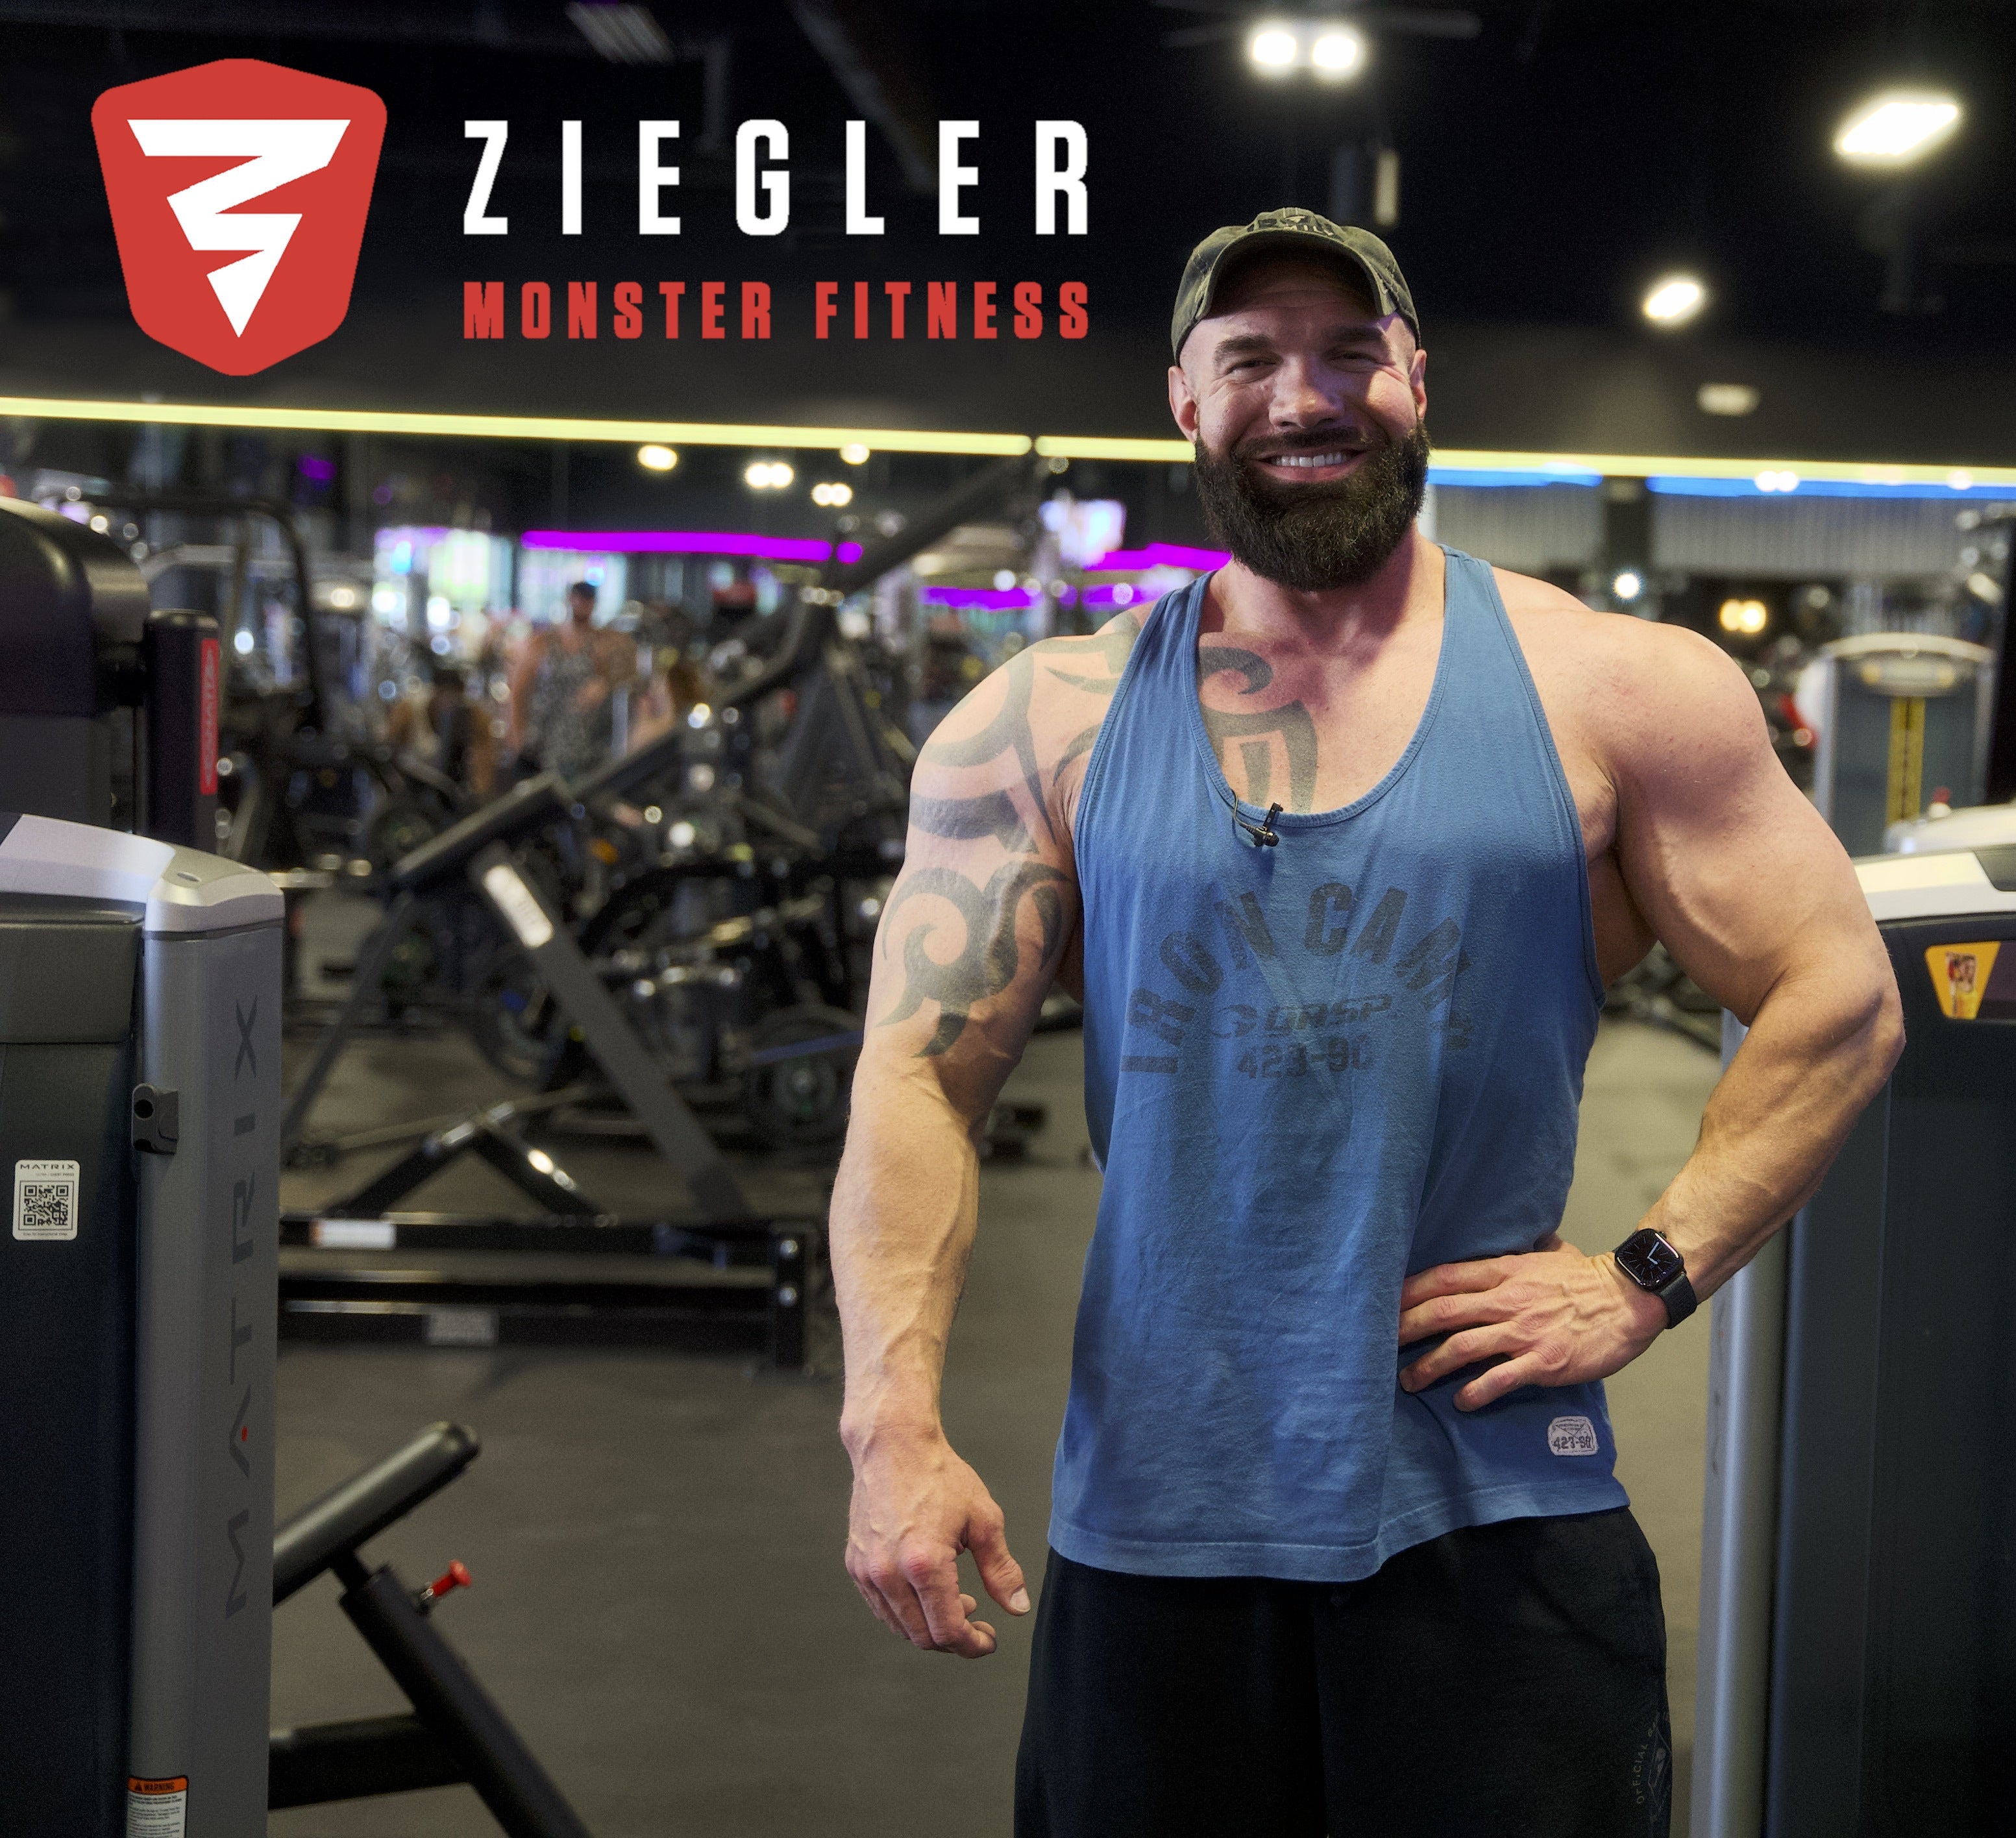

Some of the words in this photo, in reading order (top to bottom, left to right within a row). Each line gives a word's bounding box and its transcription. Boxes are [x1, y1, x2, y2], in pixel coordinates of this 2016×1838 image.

[1122, 891, 1277, 1074] IRON
[1237, 1036, 1371, 1079] 423-90
[227, 994, 257, 1619] MATRIX
[144, 1782, 175, 1791] WARNING
